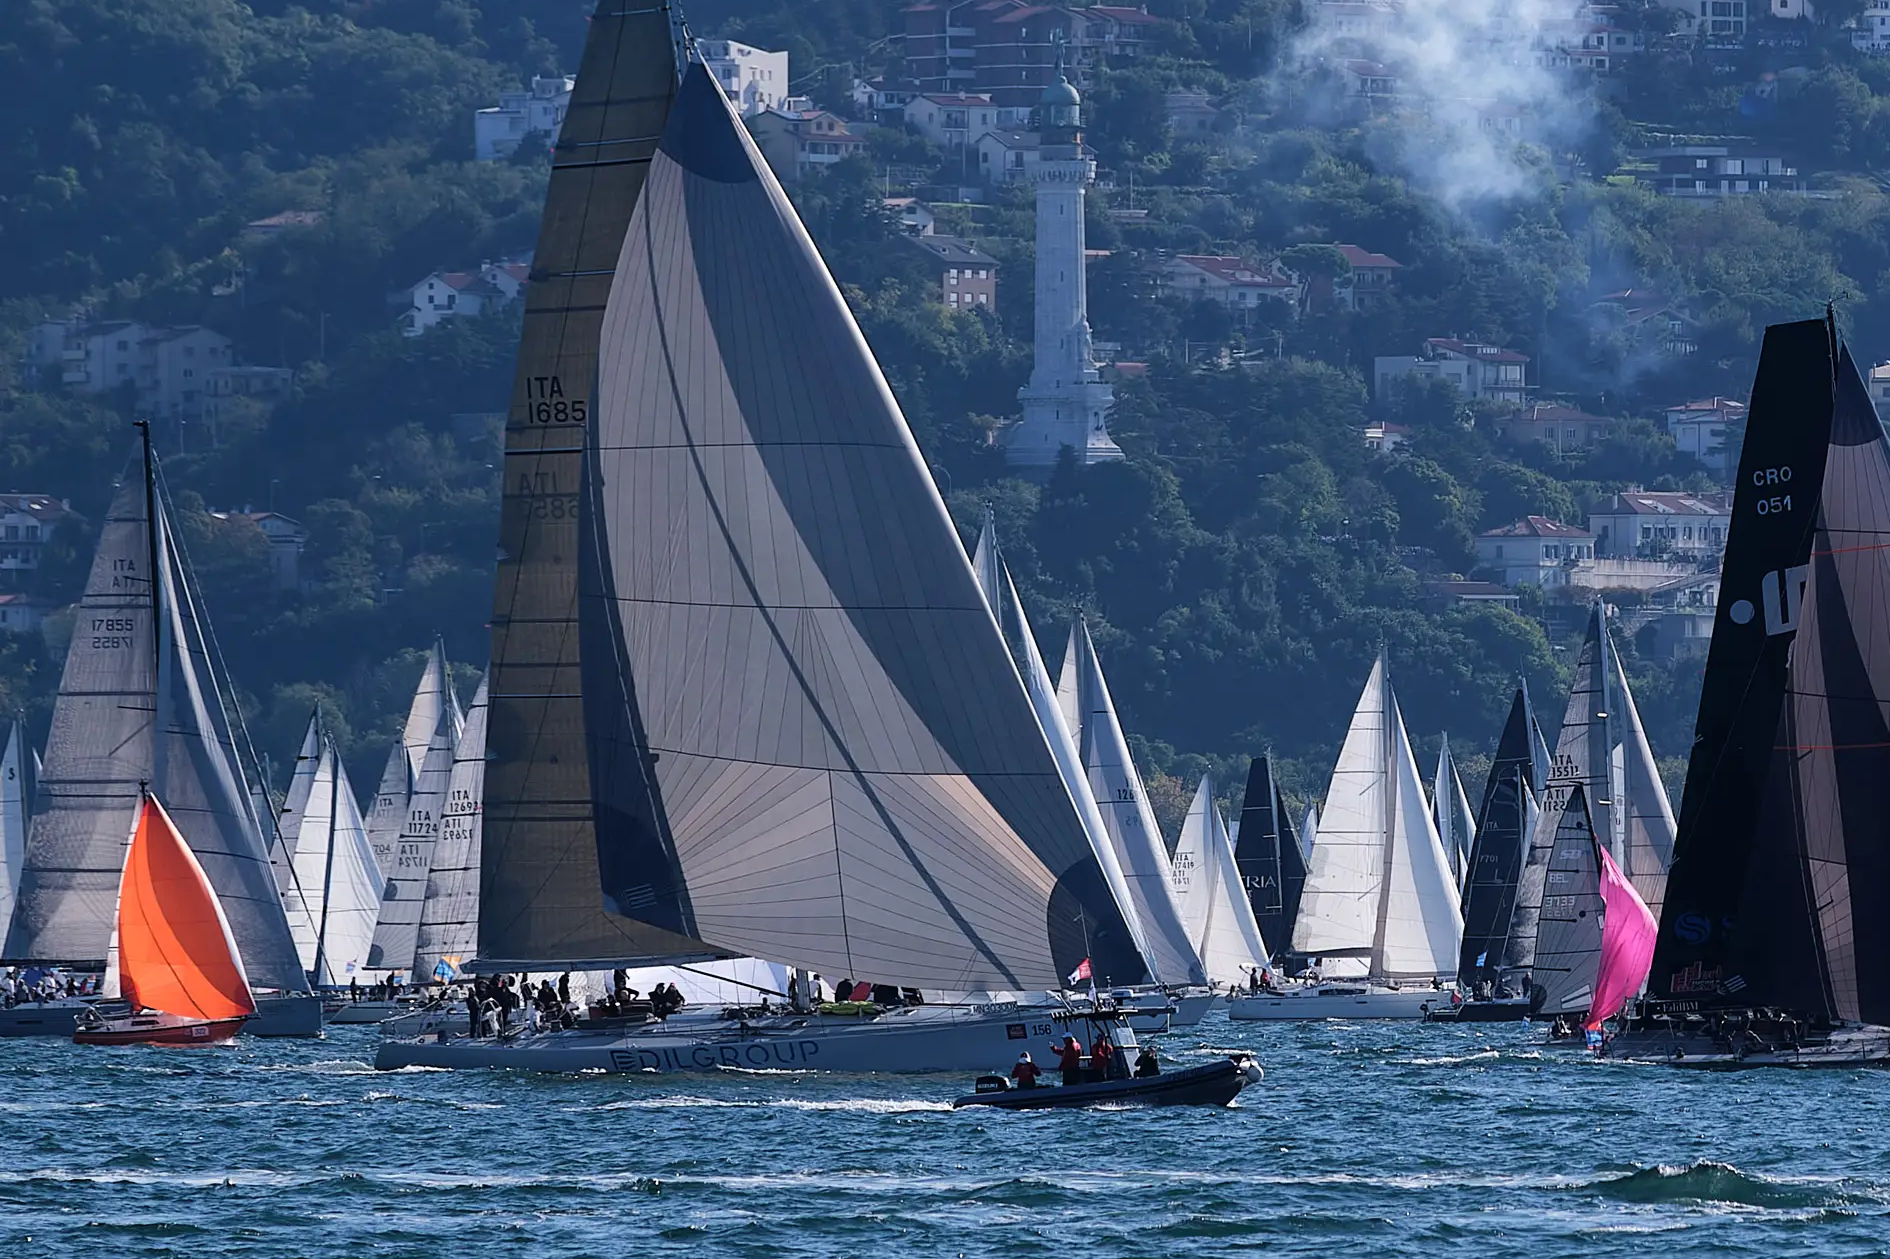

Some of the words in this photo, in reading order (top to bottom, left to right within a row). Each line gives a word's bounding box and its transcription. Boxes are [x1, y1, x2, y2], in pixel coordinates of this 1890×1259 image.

[527, 376, 563, 399] ITA
[528, 400, 586, 424] 1685
[1753, 466, 1792, 486] CRO
[1757, 495, 1792, 515] 051
[113, 559, 135, 571] ITA
[92, 619, 134, 631] 17855
[1554, 754, 1572, 766] ITA
[453, 791, 469, 800] ITA
[380, 798, 393, 807] ITA
[412, 811, 431, 821] ITA
[408, 823, 438, 834] 11724
[1486, 822, 1499, 830] ITA
[1033, 1024, 1052, 1036] 156
[610, 1040, 819, 1070] EDILGROUP
